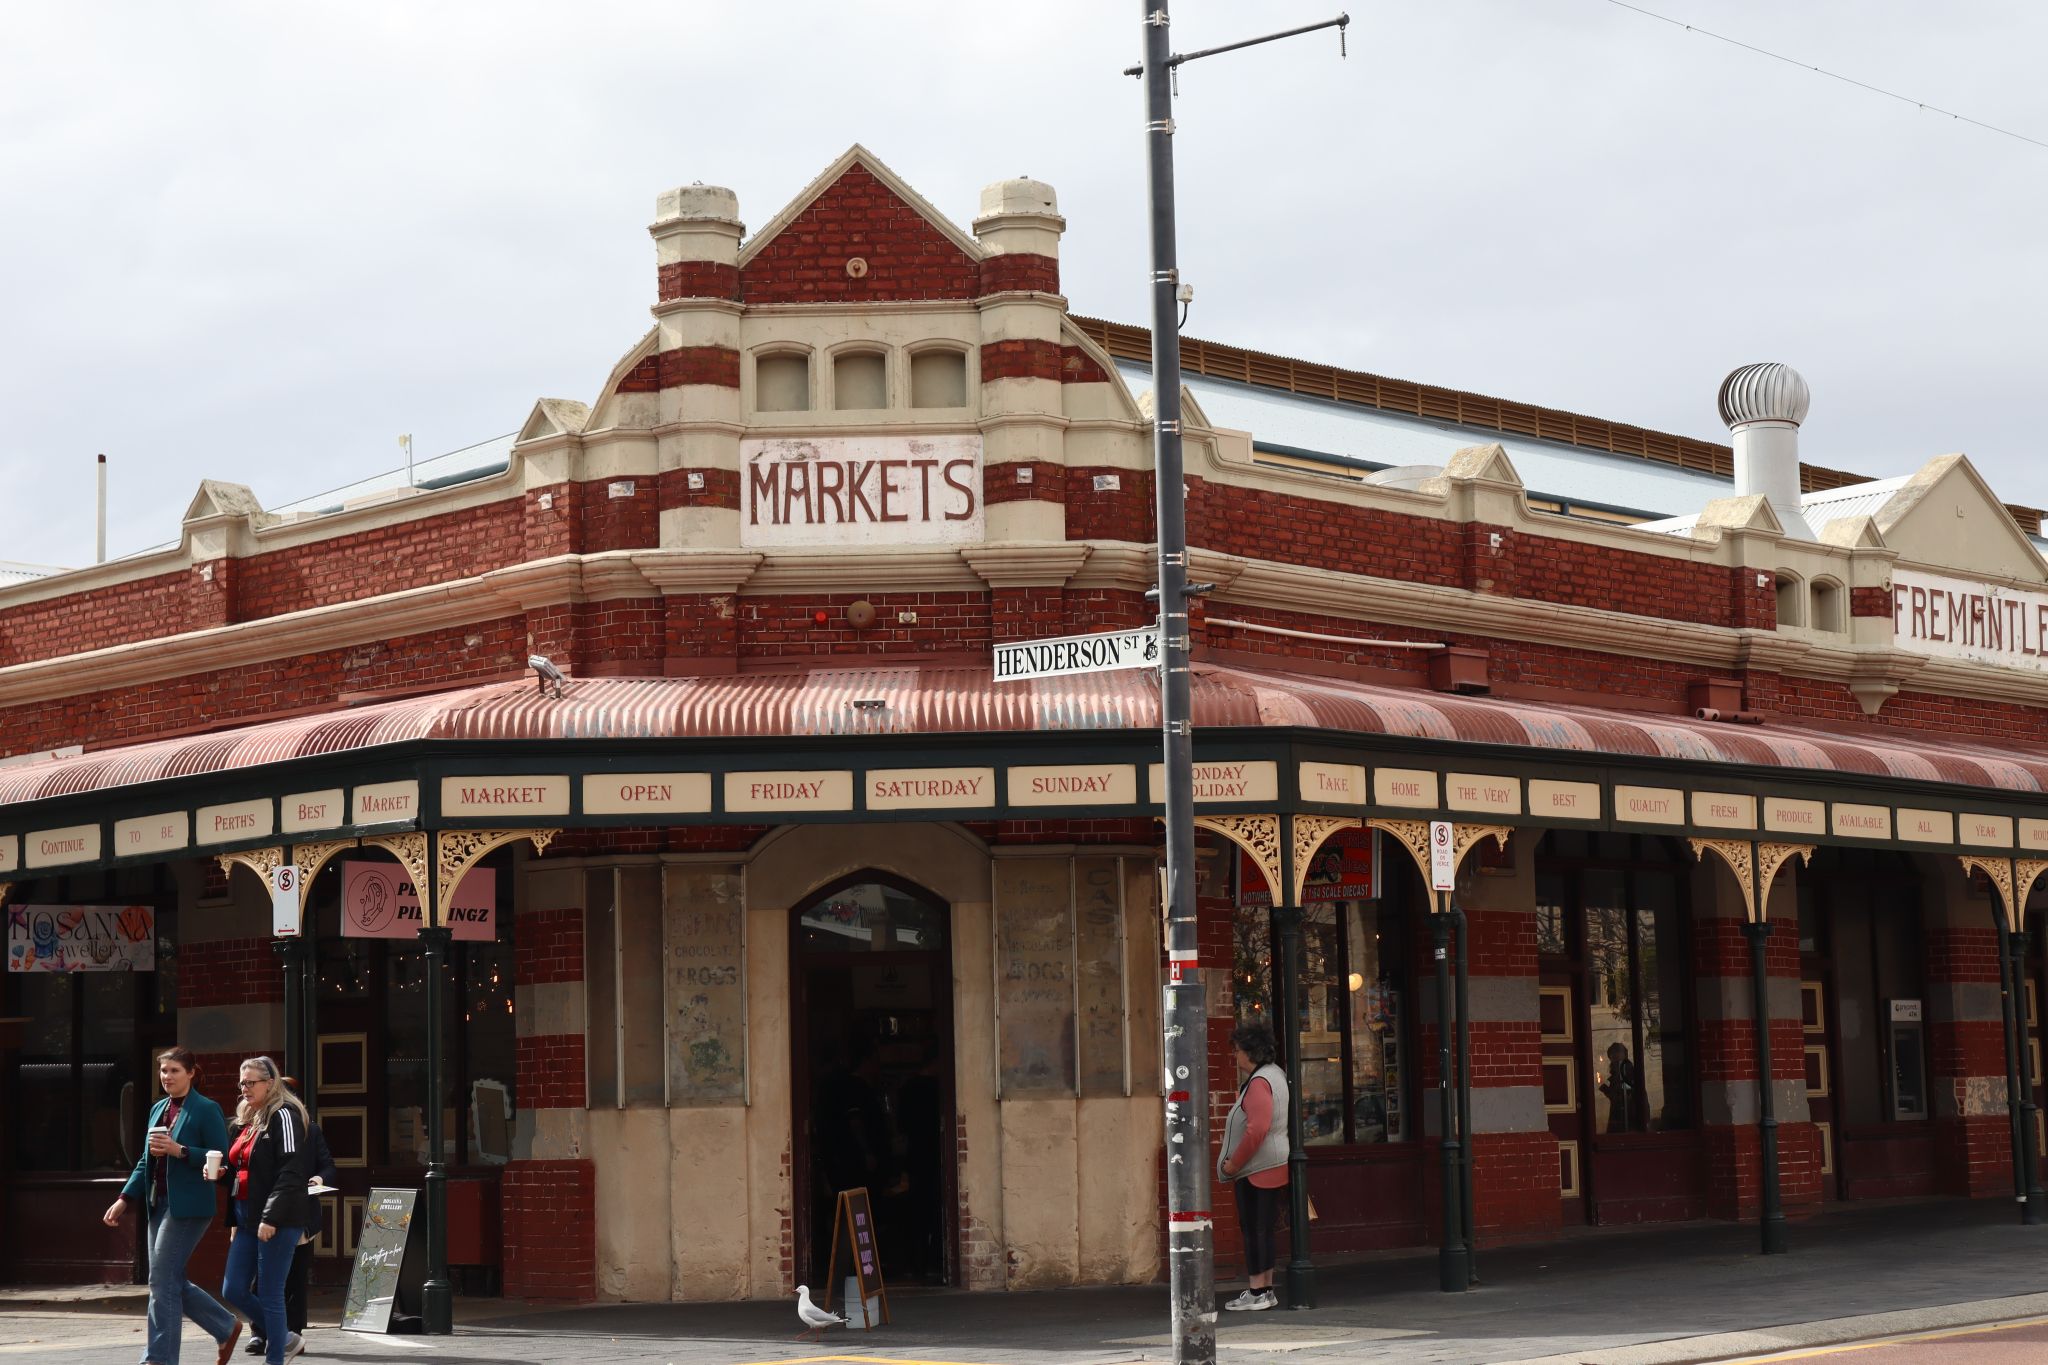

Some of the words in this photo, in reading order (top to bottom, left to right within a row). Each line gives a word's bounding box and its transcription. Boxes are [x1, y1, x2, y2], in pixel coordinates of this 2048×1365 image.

[749, 460, 975, 525] MARKETS
[997, 637, 1121, 676] HENDERSON
[1123, 635, 1140, 649] ST
[1191, 764, 1246, 780] ONDAY
[750, 779, 825, 800] FRIDAY
[875, 776, 984, 797] SATURDAY
[1032, 773, 1112, 793] SUNDAY
[1192, 781, 1248, 797] OLIDAY
[1391, 782, 1420, 797] HOME
[460, 787, 546, 804] MARKET
[620, 785, 672, 801] OPEN
[1457, 787, 1478, 800] THE
[1483, 788, 1511, 803] VERY
[1552, 794, 1577, 807] BEST
[298, 803, 327, 820] BEST
[361, 795, 410, 813] MARKET
[1629, 798, 1670, 813] QUALITY
[1711, 805, 1738, 818] FRESH
[1776, 809, 1813, 824] PRODUCE
[1839, 814, 1884, 829] AVAILABLE
[129, 830, 141, 843] TO
[161, 826, 174, 839] BE
[1917, 821, 1933, 833] ALL
[1975, 823, 1996, 838] YEAR
[1321, 886, 1341, 898] SCALE
[1343, 884, 1369, 897] DIECAST
[1171, 962, 1180, 978] H
